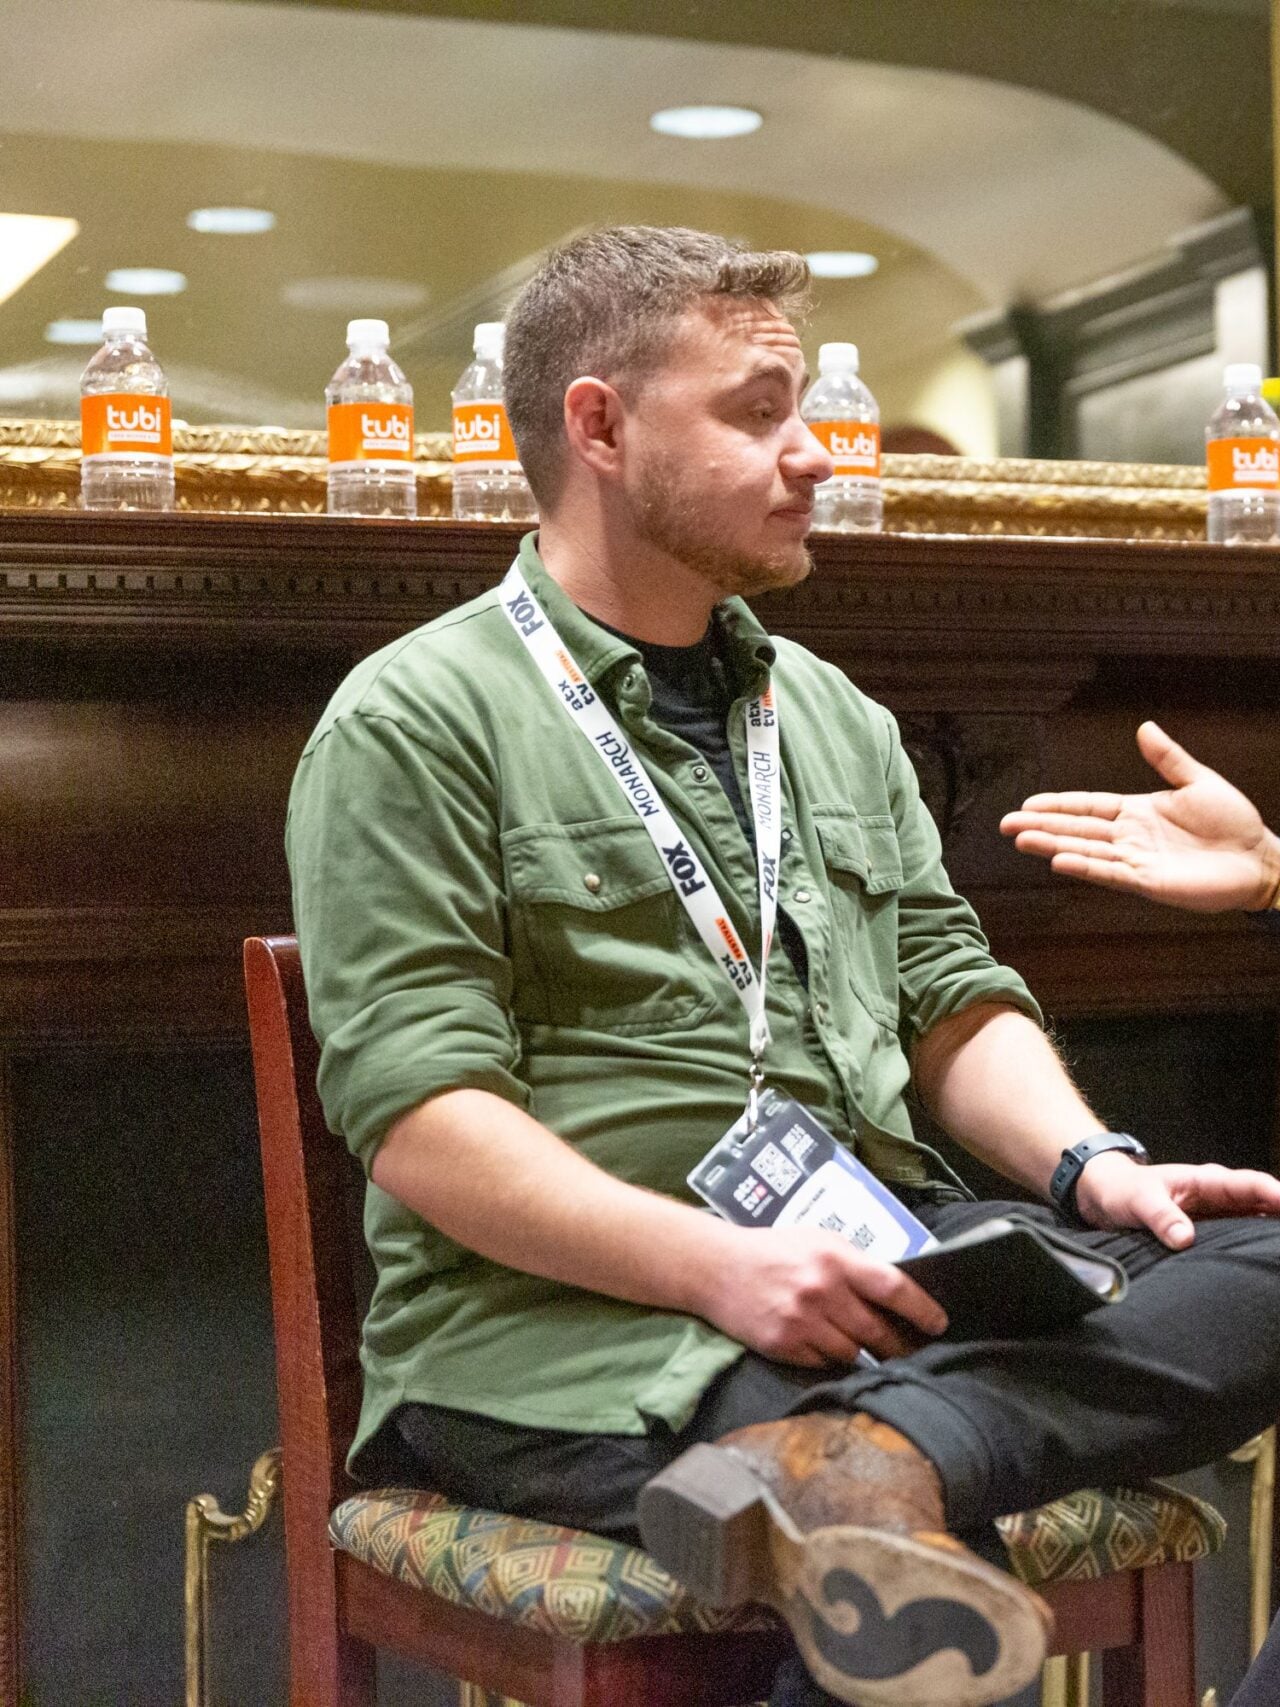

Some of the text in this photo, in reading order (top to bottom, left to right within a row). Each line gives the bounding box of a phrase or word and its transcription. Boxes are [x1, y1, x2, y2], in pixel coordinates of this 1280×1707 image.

[106, 404, 160, 431] tubi
[361, 414, 410, 440] tubi
[454, 413, 500, 440] tubi
[830, 432, 876, 457] tubi
[1232, 447, 1279, 471] tubi
[506, 590, 544, 636] FOX
[558, 680, 583, 711] atx
[595, 731, 659, 817] MONARCH
[753, 751, 777, 830] MONARCH
[662, 840, 706, 897] FOX
[762, 850, 777, 902] FOX
[721, 954, 746, 991] atx
